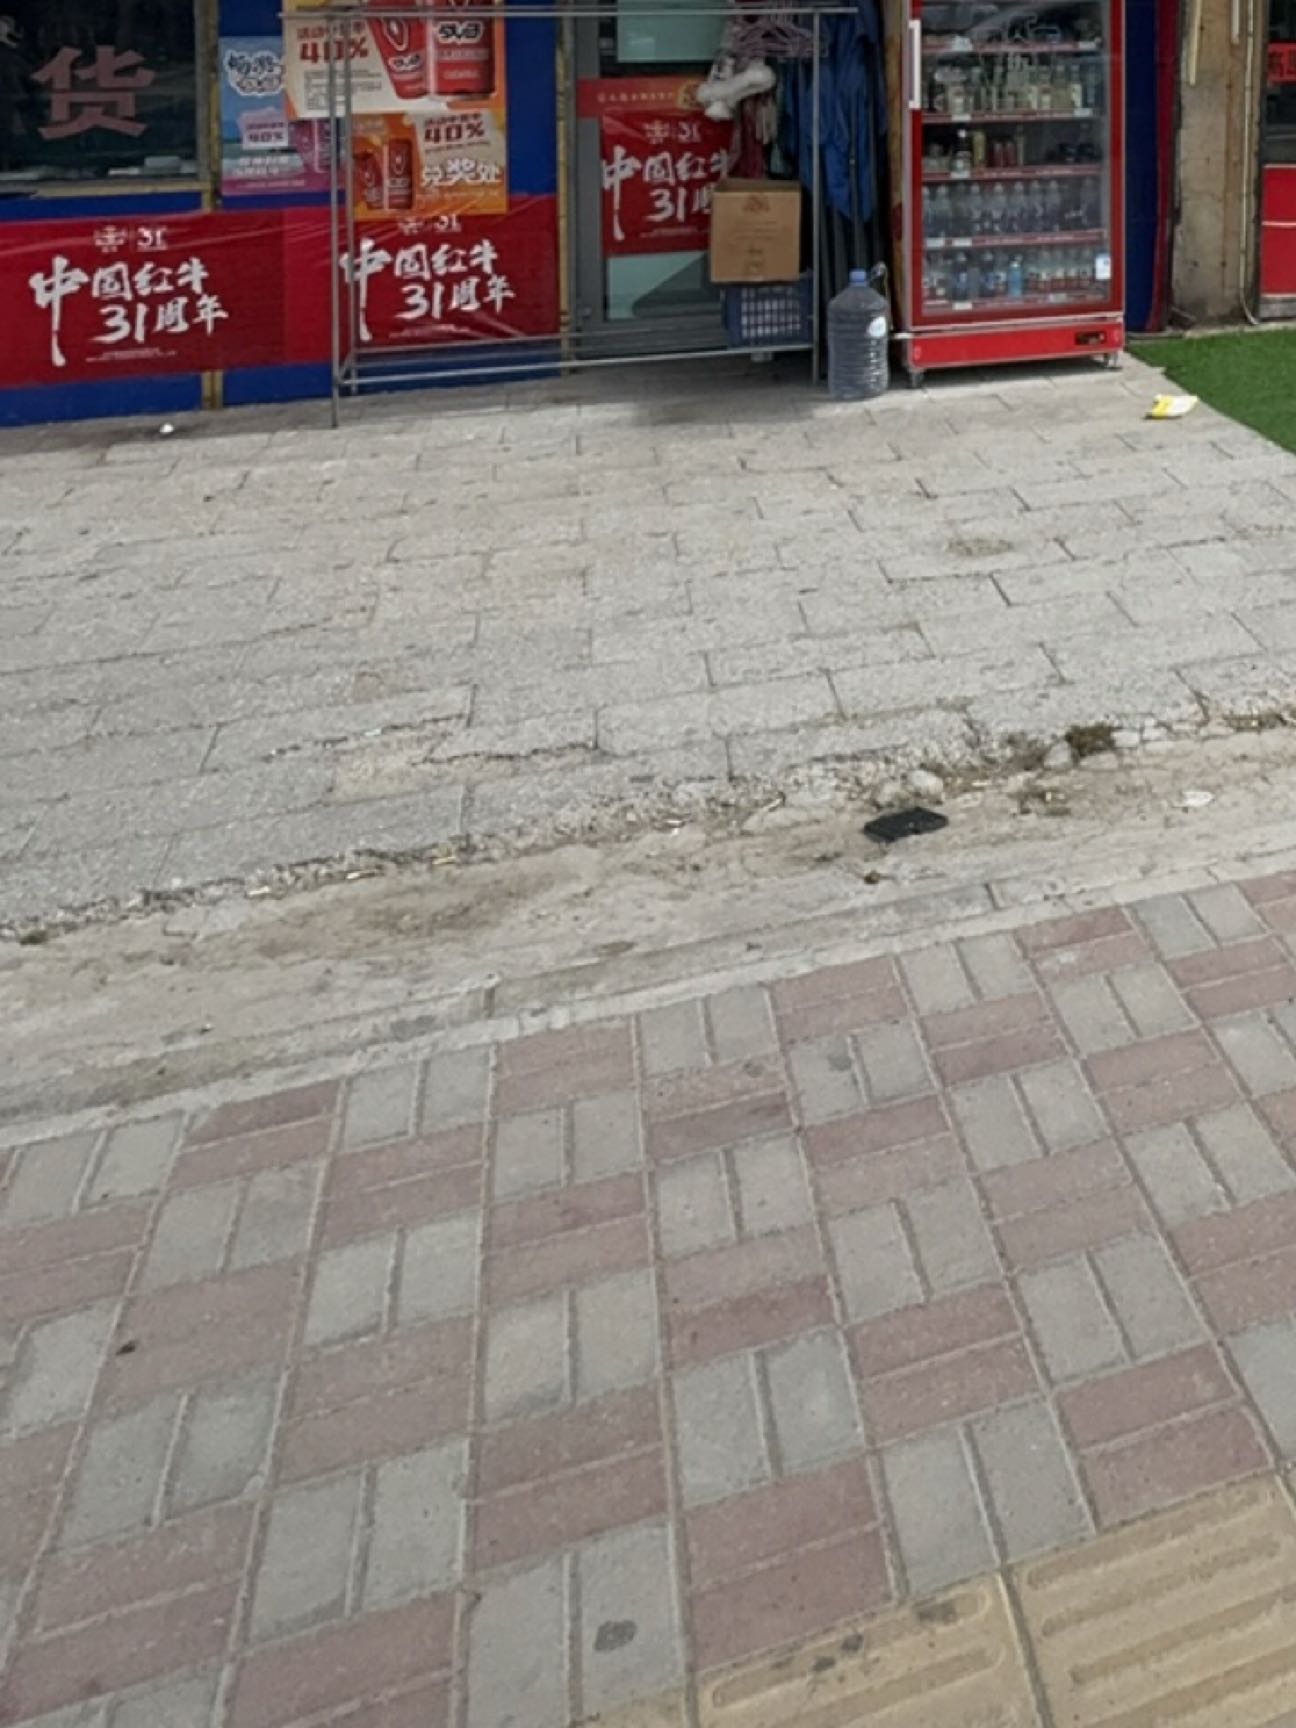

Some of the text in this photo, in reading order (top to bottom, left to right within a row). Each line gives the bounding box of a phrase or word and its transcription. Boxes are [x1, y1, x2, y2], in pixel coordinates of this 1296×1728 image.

[424, 125, 486, 145] 40%
[29, 255, 208, 366] 中国红牛
[339, 238, 498, 342] 中国红牛
[395, 275, 516, 321] 31周年
[89, 293, 230, 344] 31周年
